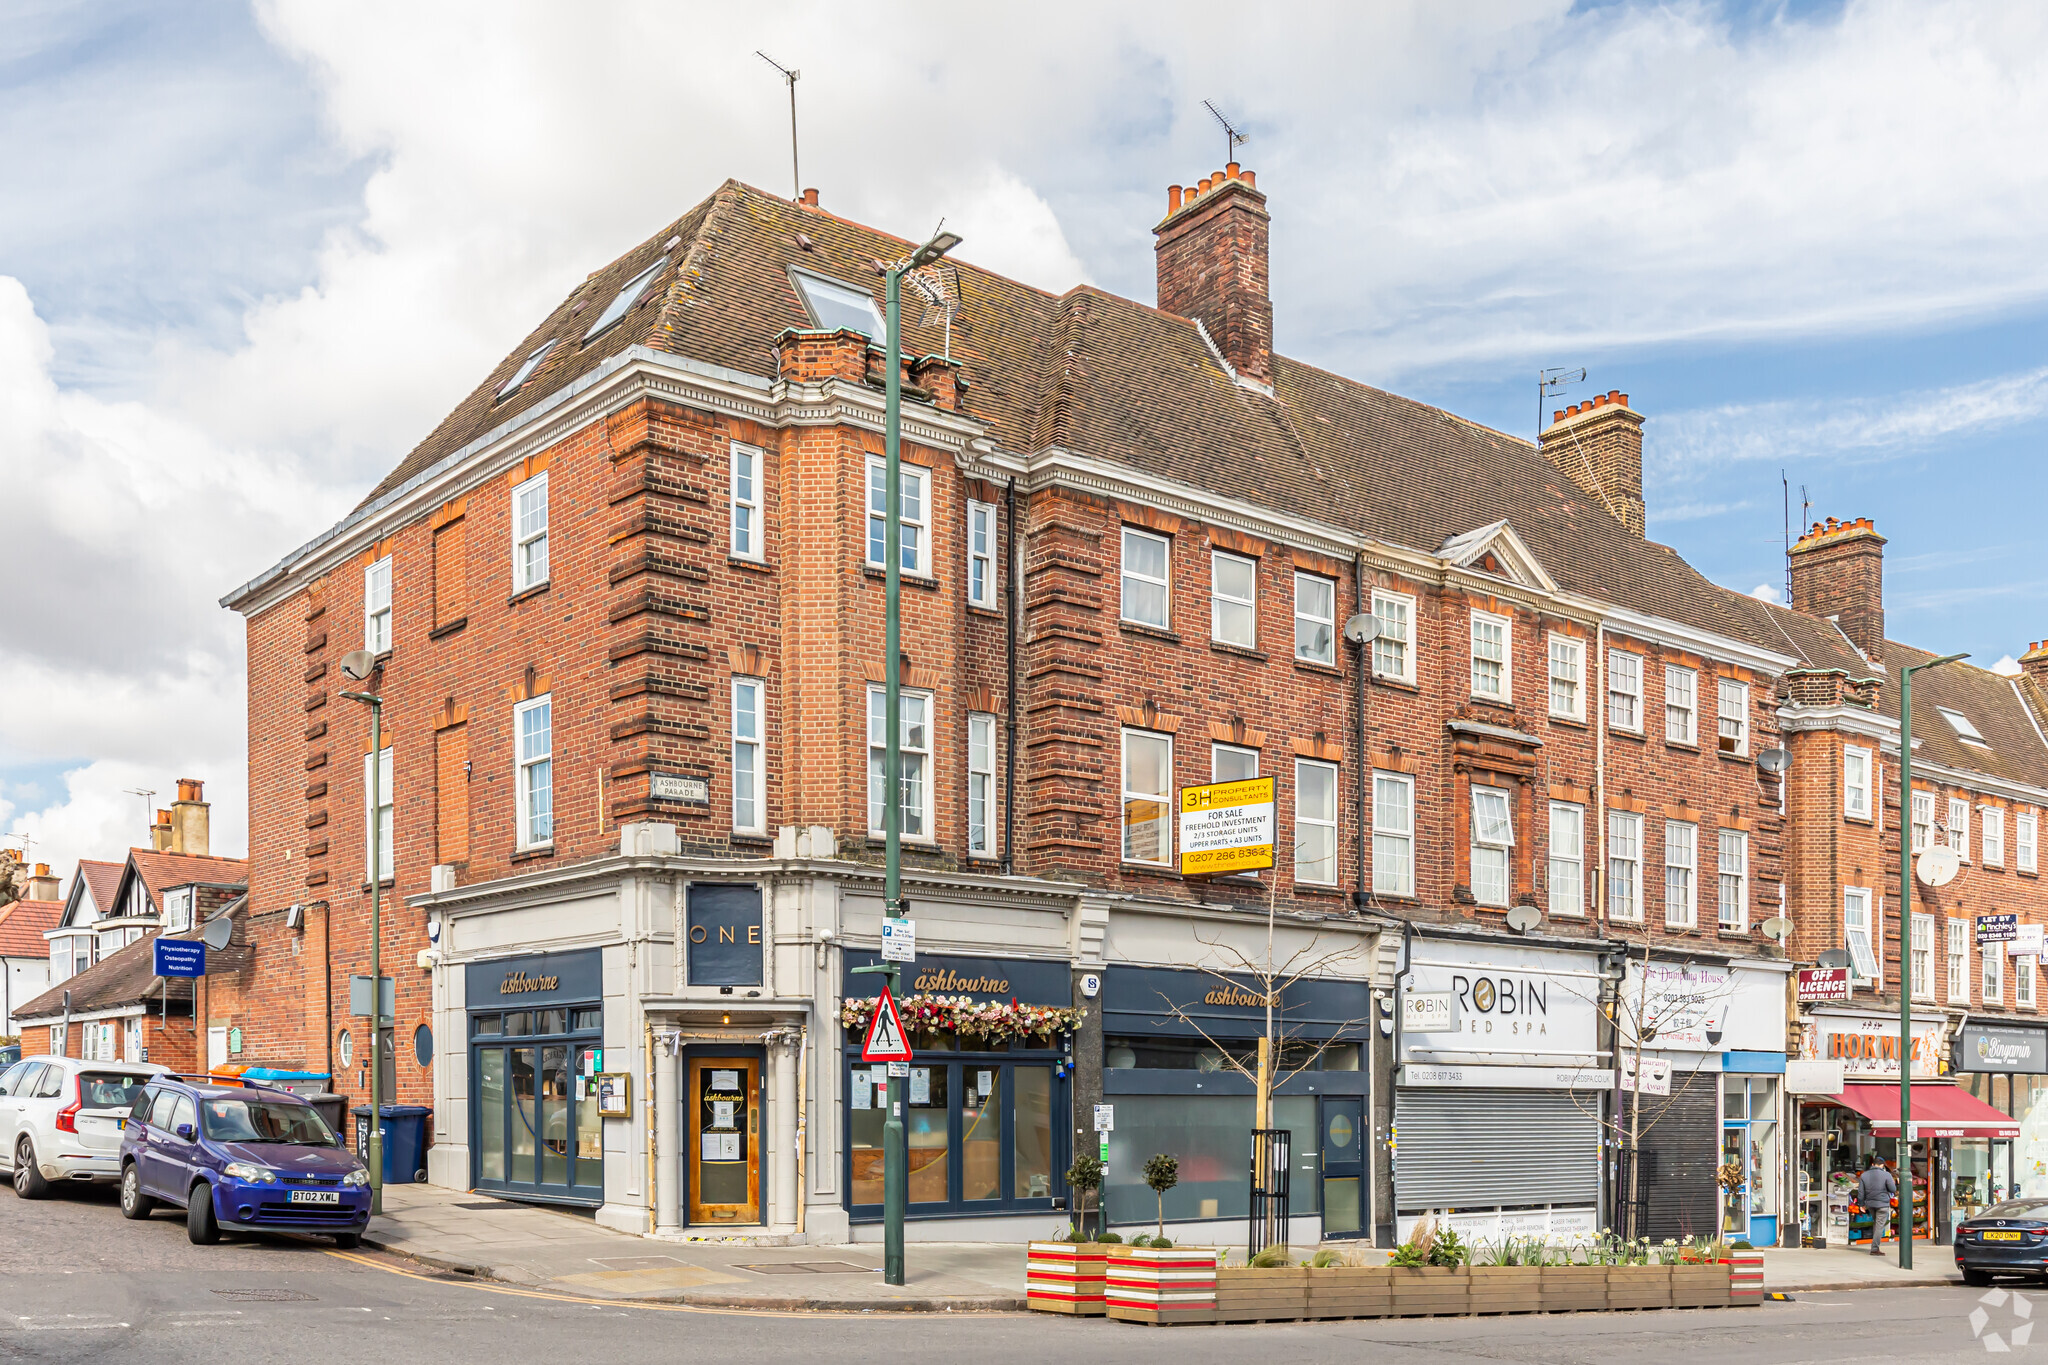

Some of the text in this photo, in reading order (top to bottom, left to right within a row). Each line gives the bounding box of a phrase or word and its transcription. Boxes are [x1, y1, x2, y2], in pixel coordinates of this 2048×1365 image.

[660, 779, 703, 790] ASHBOURNE
[1214, 785, 1268, 796] PROPERTY
[665, 788, 695, 797] PARADE
[1212, 792, 1268, 804] CONSULTANTS
[1208, 809, 1243, 820] FOR SALE
[1185, 816, 1266, 831] FREEHOLD INVESTMENT
[1206, 828, 1236, 837] STORAGE
[1237, 826, 1258, 834] UNITS
[1190, 840, 1209, 848] UPPER
[1210, 838, 1228, 846] PARTS
[1243, 835, 1262, 843] UNITS
[1189, 853, 1213, 863] 0207
[1216, 851, 1236, 861] 286
[689, 924, 761, 944] ONE
[160, 945, 201, 954] Physiotherapy
[164, 955, 197, 963] Osteopathy
[914, 968, 1010, 995] ashbourne
[1659, 966, 1697, 986] Dumpling
[1699, 970, 1724, 984] House
[1811, 970, 1834, 981] OFF
[501, 971, 559, 994] ashbourne
[1799, 980, 1846, 992] LICENCE
[1204, 985, 1281, 1008] ashboure
[1453, 975, 1547, 1016] ROBIN
[1406, 999, 1448, 1013] ROBIN
[1459, 1020, 1547, 1035] ED SPA
[1686, 1033, 1701, 1042] Food
[1832, 1033, 1921, 1060] HORMZ
[1988, 1037, 2032, 1062] Binyamin
[1421, 1071, 1437, 1080] 0208
[1438, 1071, 1447, 1081] 617
[1448, 1071, 1462, 1081] 3433
[703, 1093, 744, 1102] ashbourne
[293, 1191, 318, 1201] BT02
